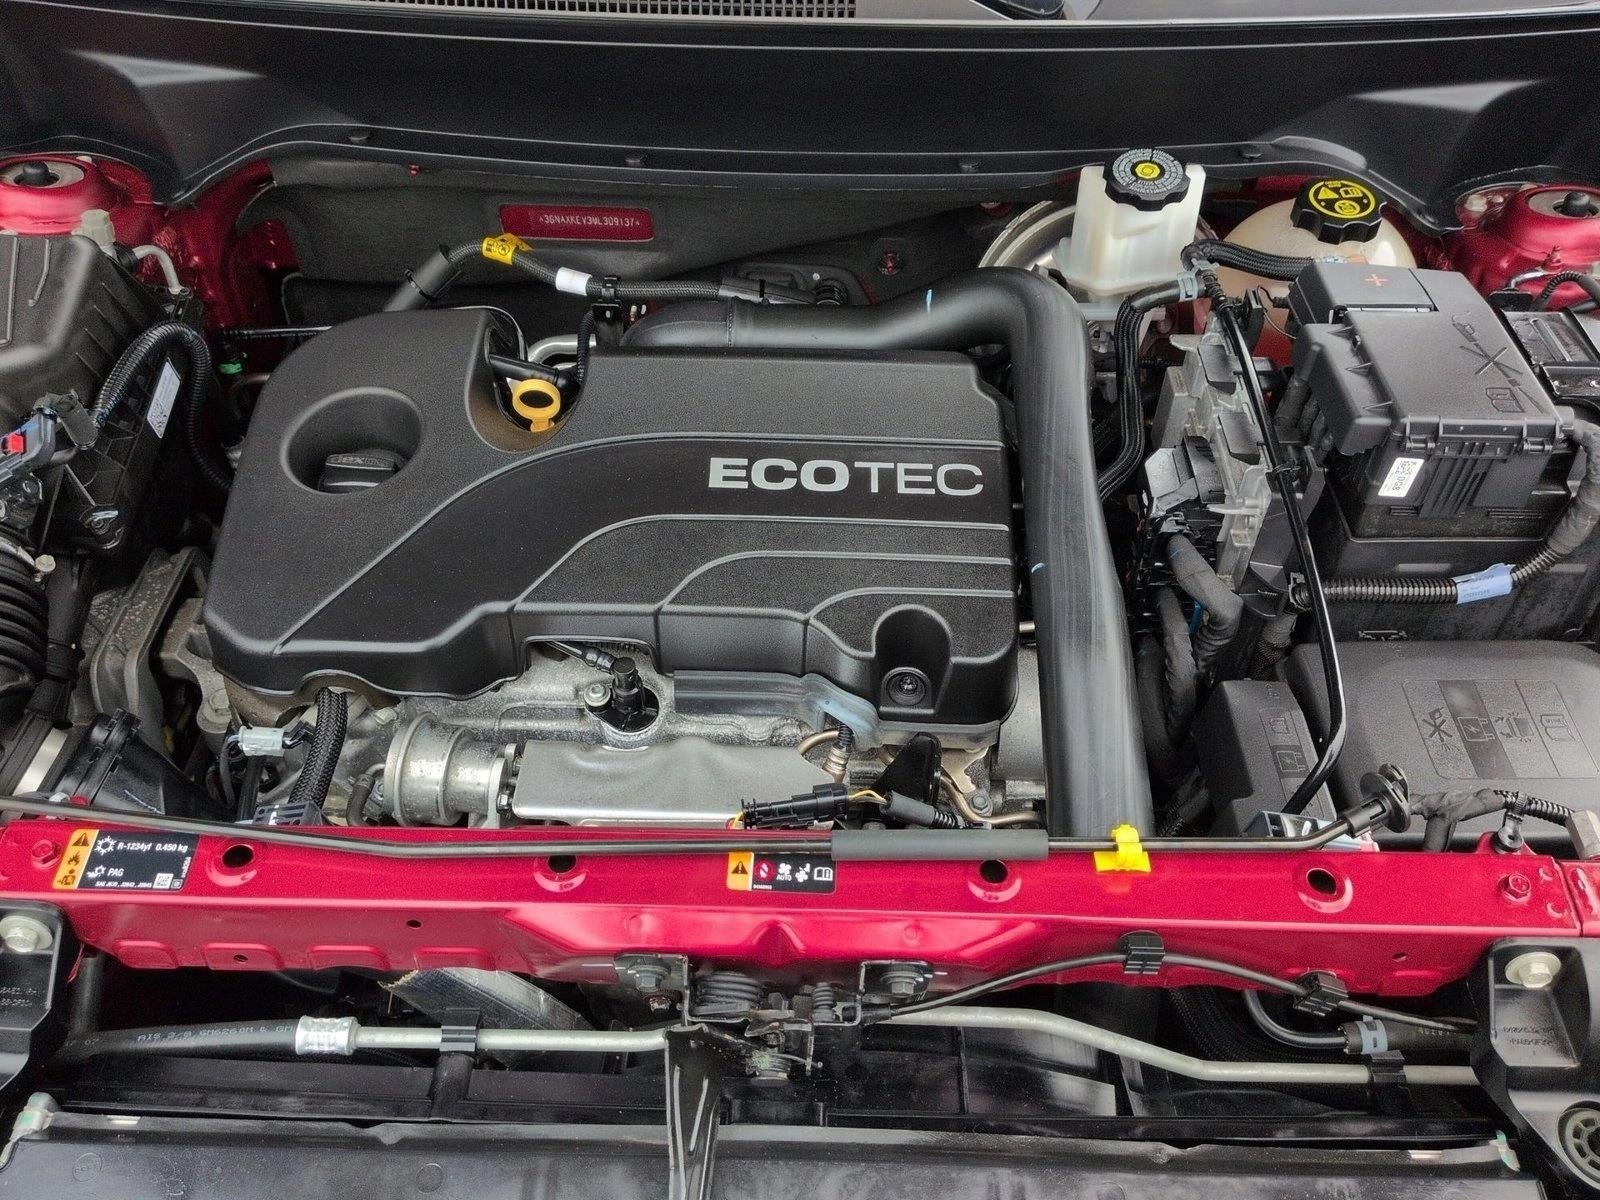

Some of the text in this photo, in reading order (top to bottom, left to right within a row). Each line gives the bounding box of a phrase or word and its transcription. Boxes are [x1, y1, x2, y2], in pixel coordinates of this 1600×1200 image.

[709, 457, 984, 496] ECOTEC
[117, 842, 188, 853] R-1234yf 0.450 kg
[107, 868, 124, 877] PAG
